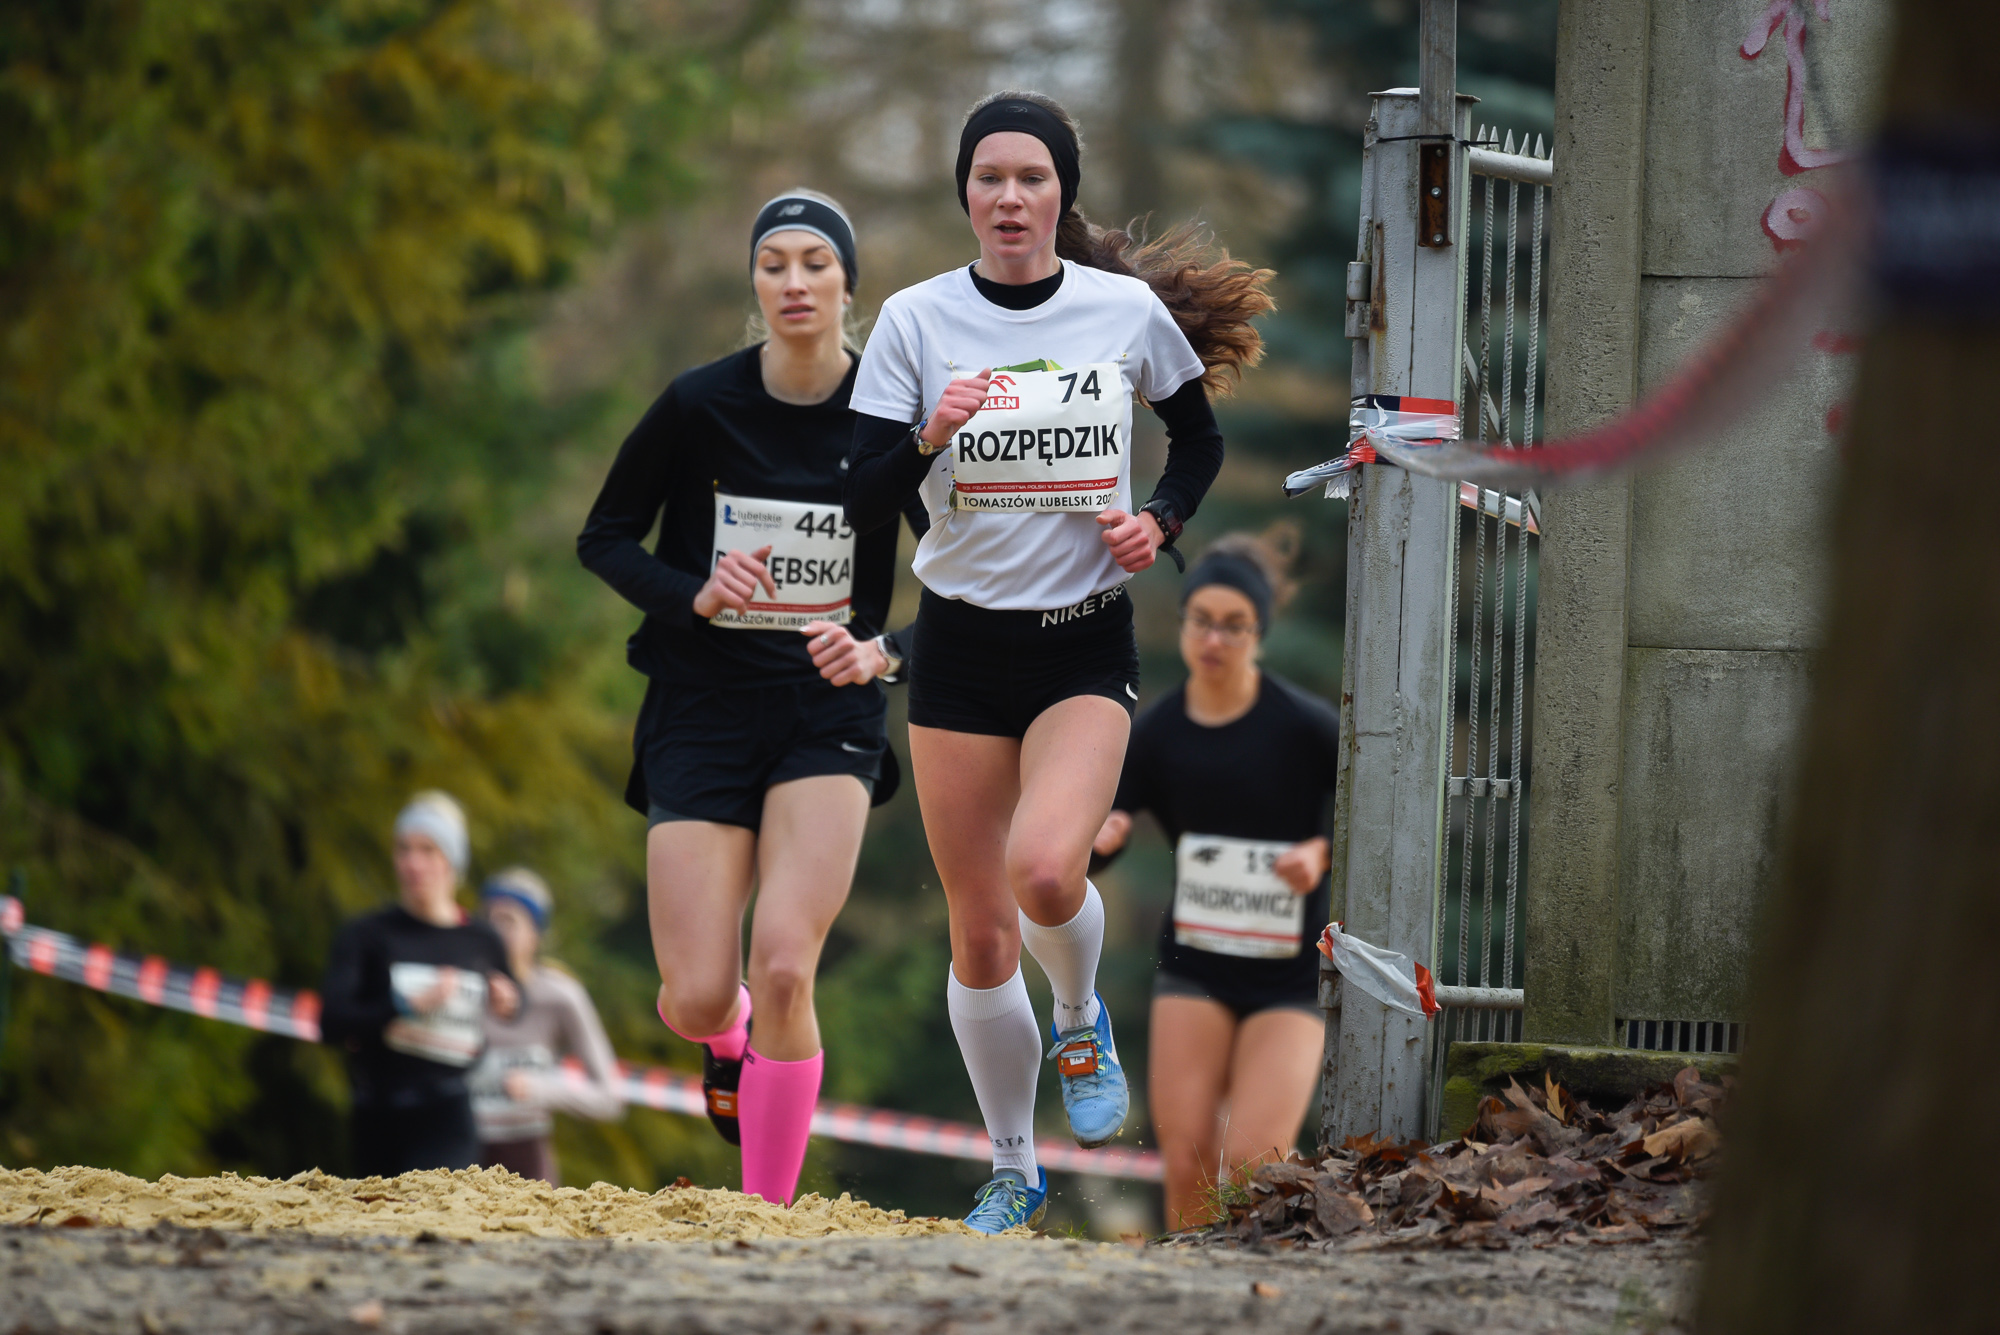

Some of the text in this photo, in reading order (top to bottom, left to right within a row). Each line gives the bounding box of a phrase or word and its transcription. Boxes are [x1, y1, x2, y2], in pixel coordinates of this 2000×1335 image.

[1058, 369, 1102, 404] 74
[980, 397, 1017, 409] RLEN
[958, 423, 1120, 466] ROZPĘDZIK
[963, 491, 1113, 508] TOMASZÓW LUBELSKI 202
[737, 509, 782, 524] lubelskie
[713, 612, 775, 625] OMASZÓW
[1041, 598, 1097, 628] NIKE
